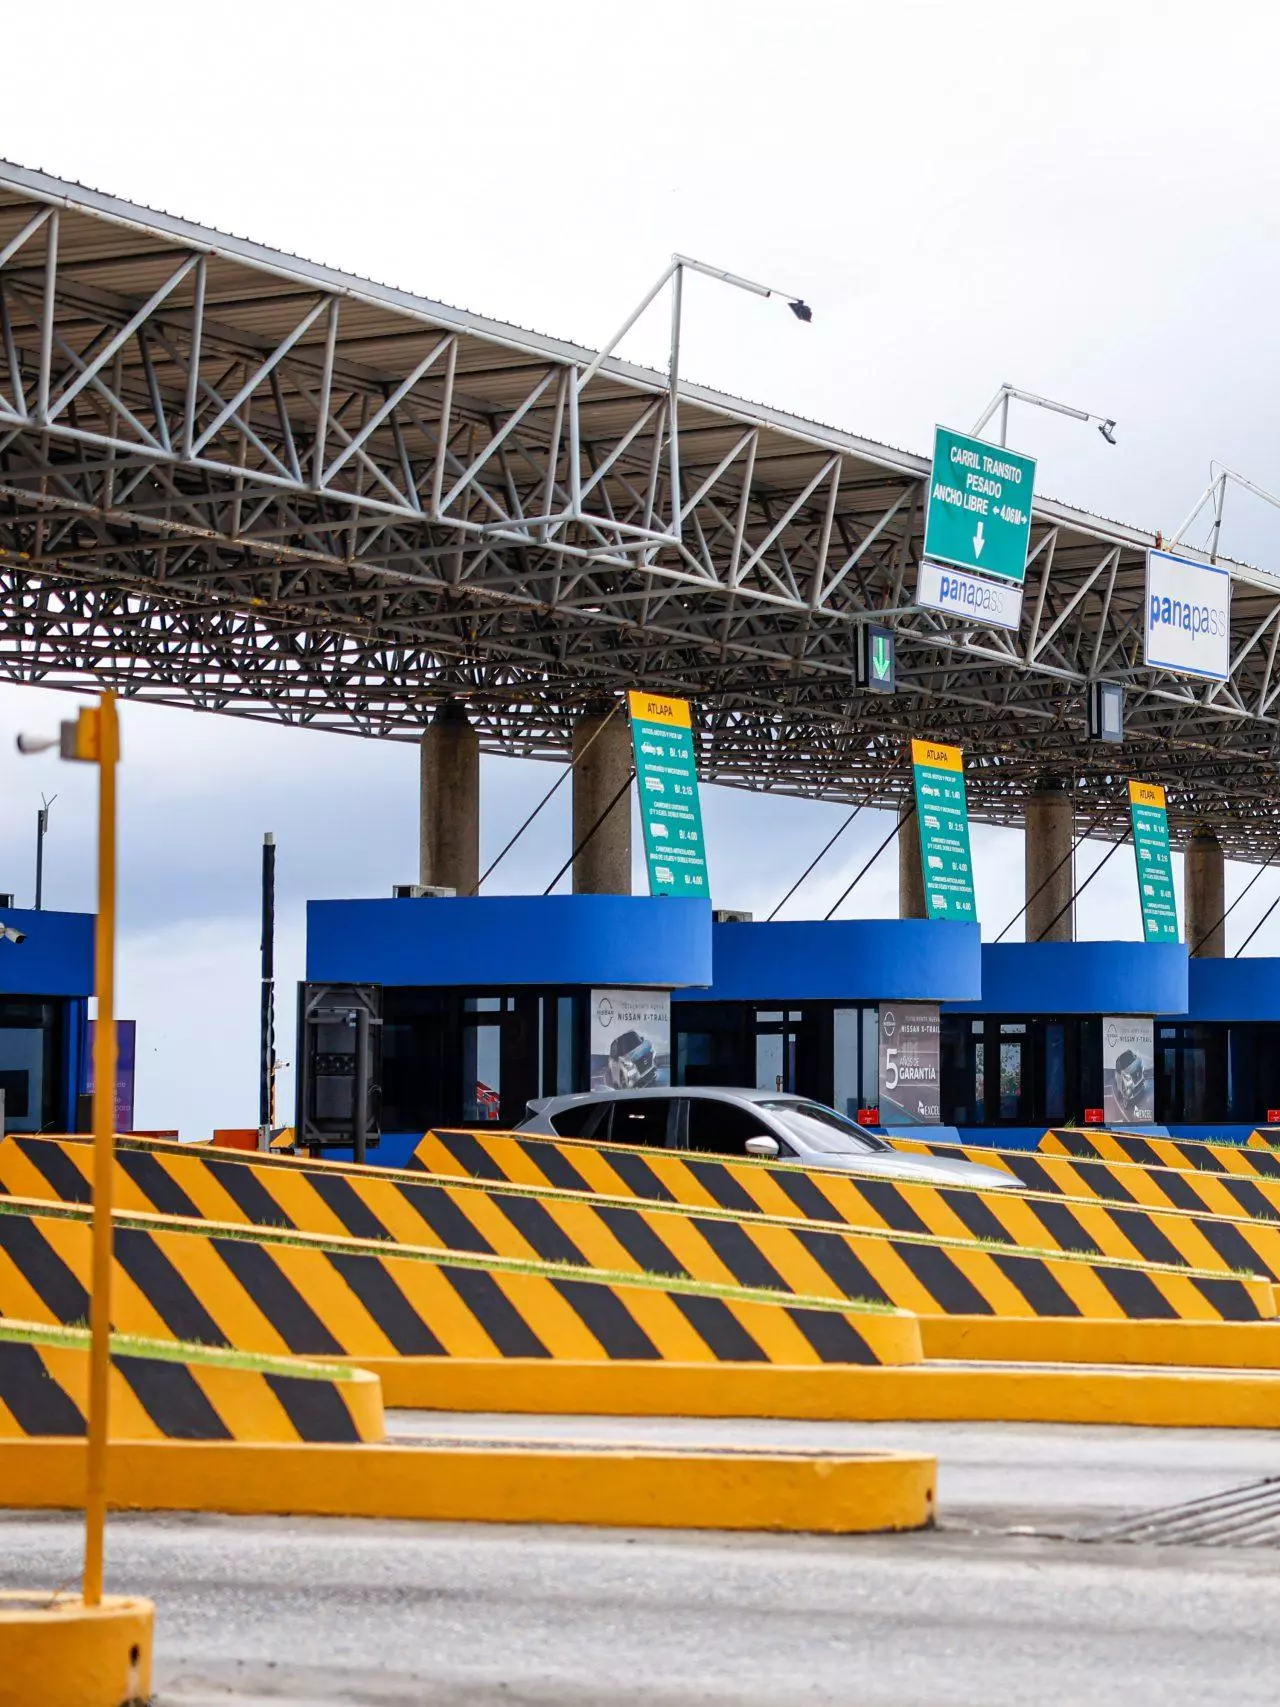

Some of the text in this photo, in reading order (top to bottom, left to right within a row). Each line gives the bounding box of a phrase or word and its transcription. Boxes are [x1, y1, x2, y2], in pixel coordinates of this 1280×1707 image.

[950, 446, 1022, 484] CARRIL TRANSITO
[966, 473, 1002, 499] PESADO
[932, 483, 963, 507] ANCHO
[963, 493, 989, 516] LIBRE
[940, 575, 1003, 614] panapass
[1150, 594, 1226, 641] panapass
[647, 702, 673, 716] ATLAPA
[926, 749, 948, 762] ATLAPA
[1140, 789, 1156, 800] ATLAPA
[617, 1012, 668, 1021] NISSAN X-TRAIL
[901, 1025, 940, 1033] NISSAN X-TRAIL
[885, 1048, 899, 1090] 5
[899, 1064, 936, 1080] GARANTÍA
[924, 1105, 940, 1116] EXCEL
